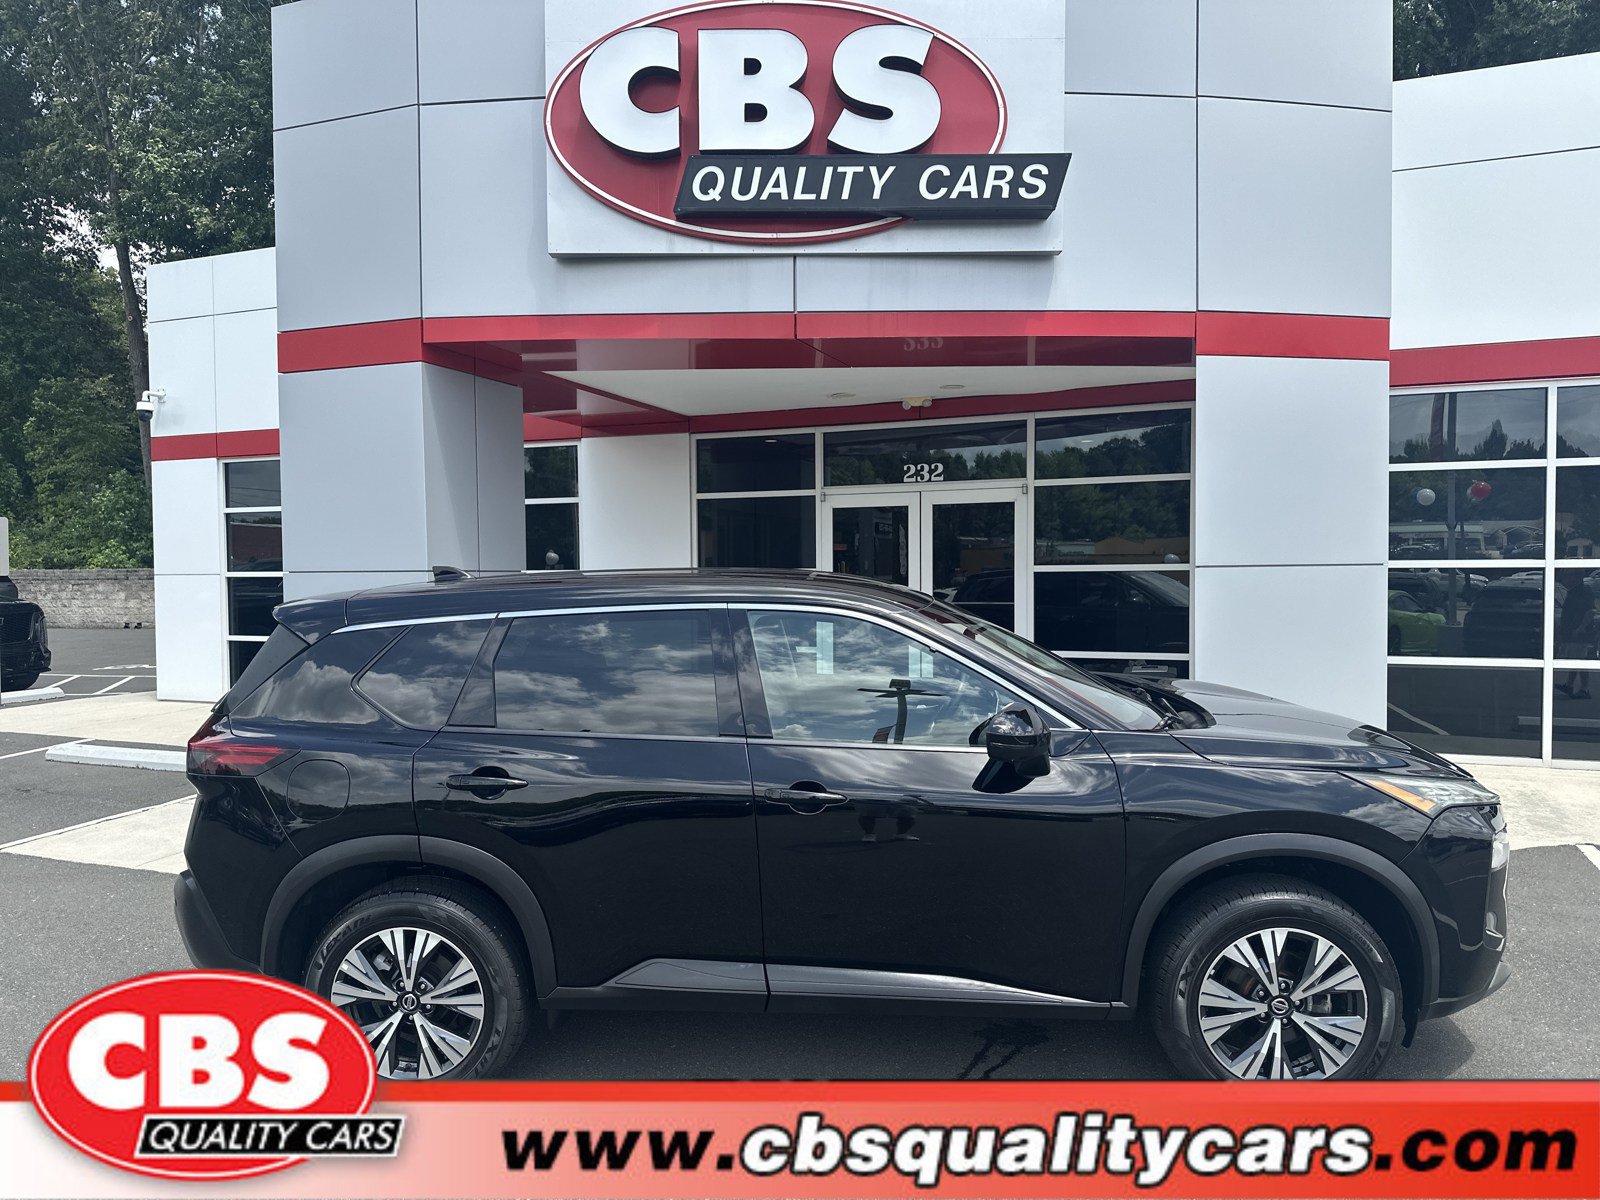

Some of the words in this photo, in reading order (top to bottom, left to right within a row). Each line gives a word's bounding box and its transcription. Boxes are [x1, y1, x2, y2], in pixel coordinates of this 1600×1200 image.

[579, 24, 942, 155] CBS
[692, 165, 896, 202] QUALITY
[918, 163, 1049, 200] CARS
[903, 463, 944, 482] 232
